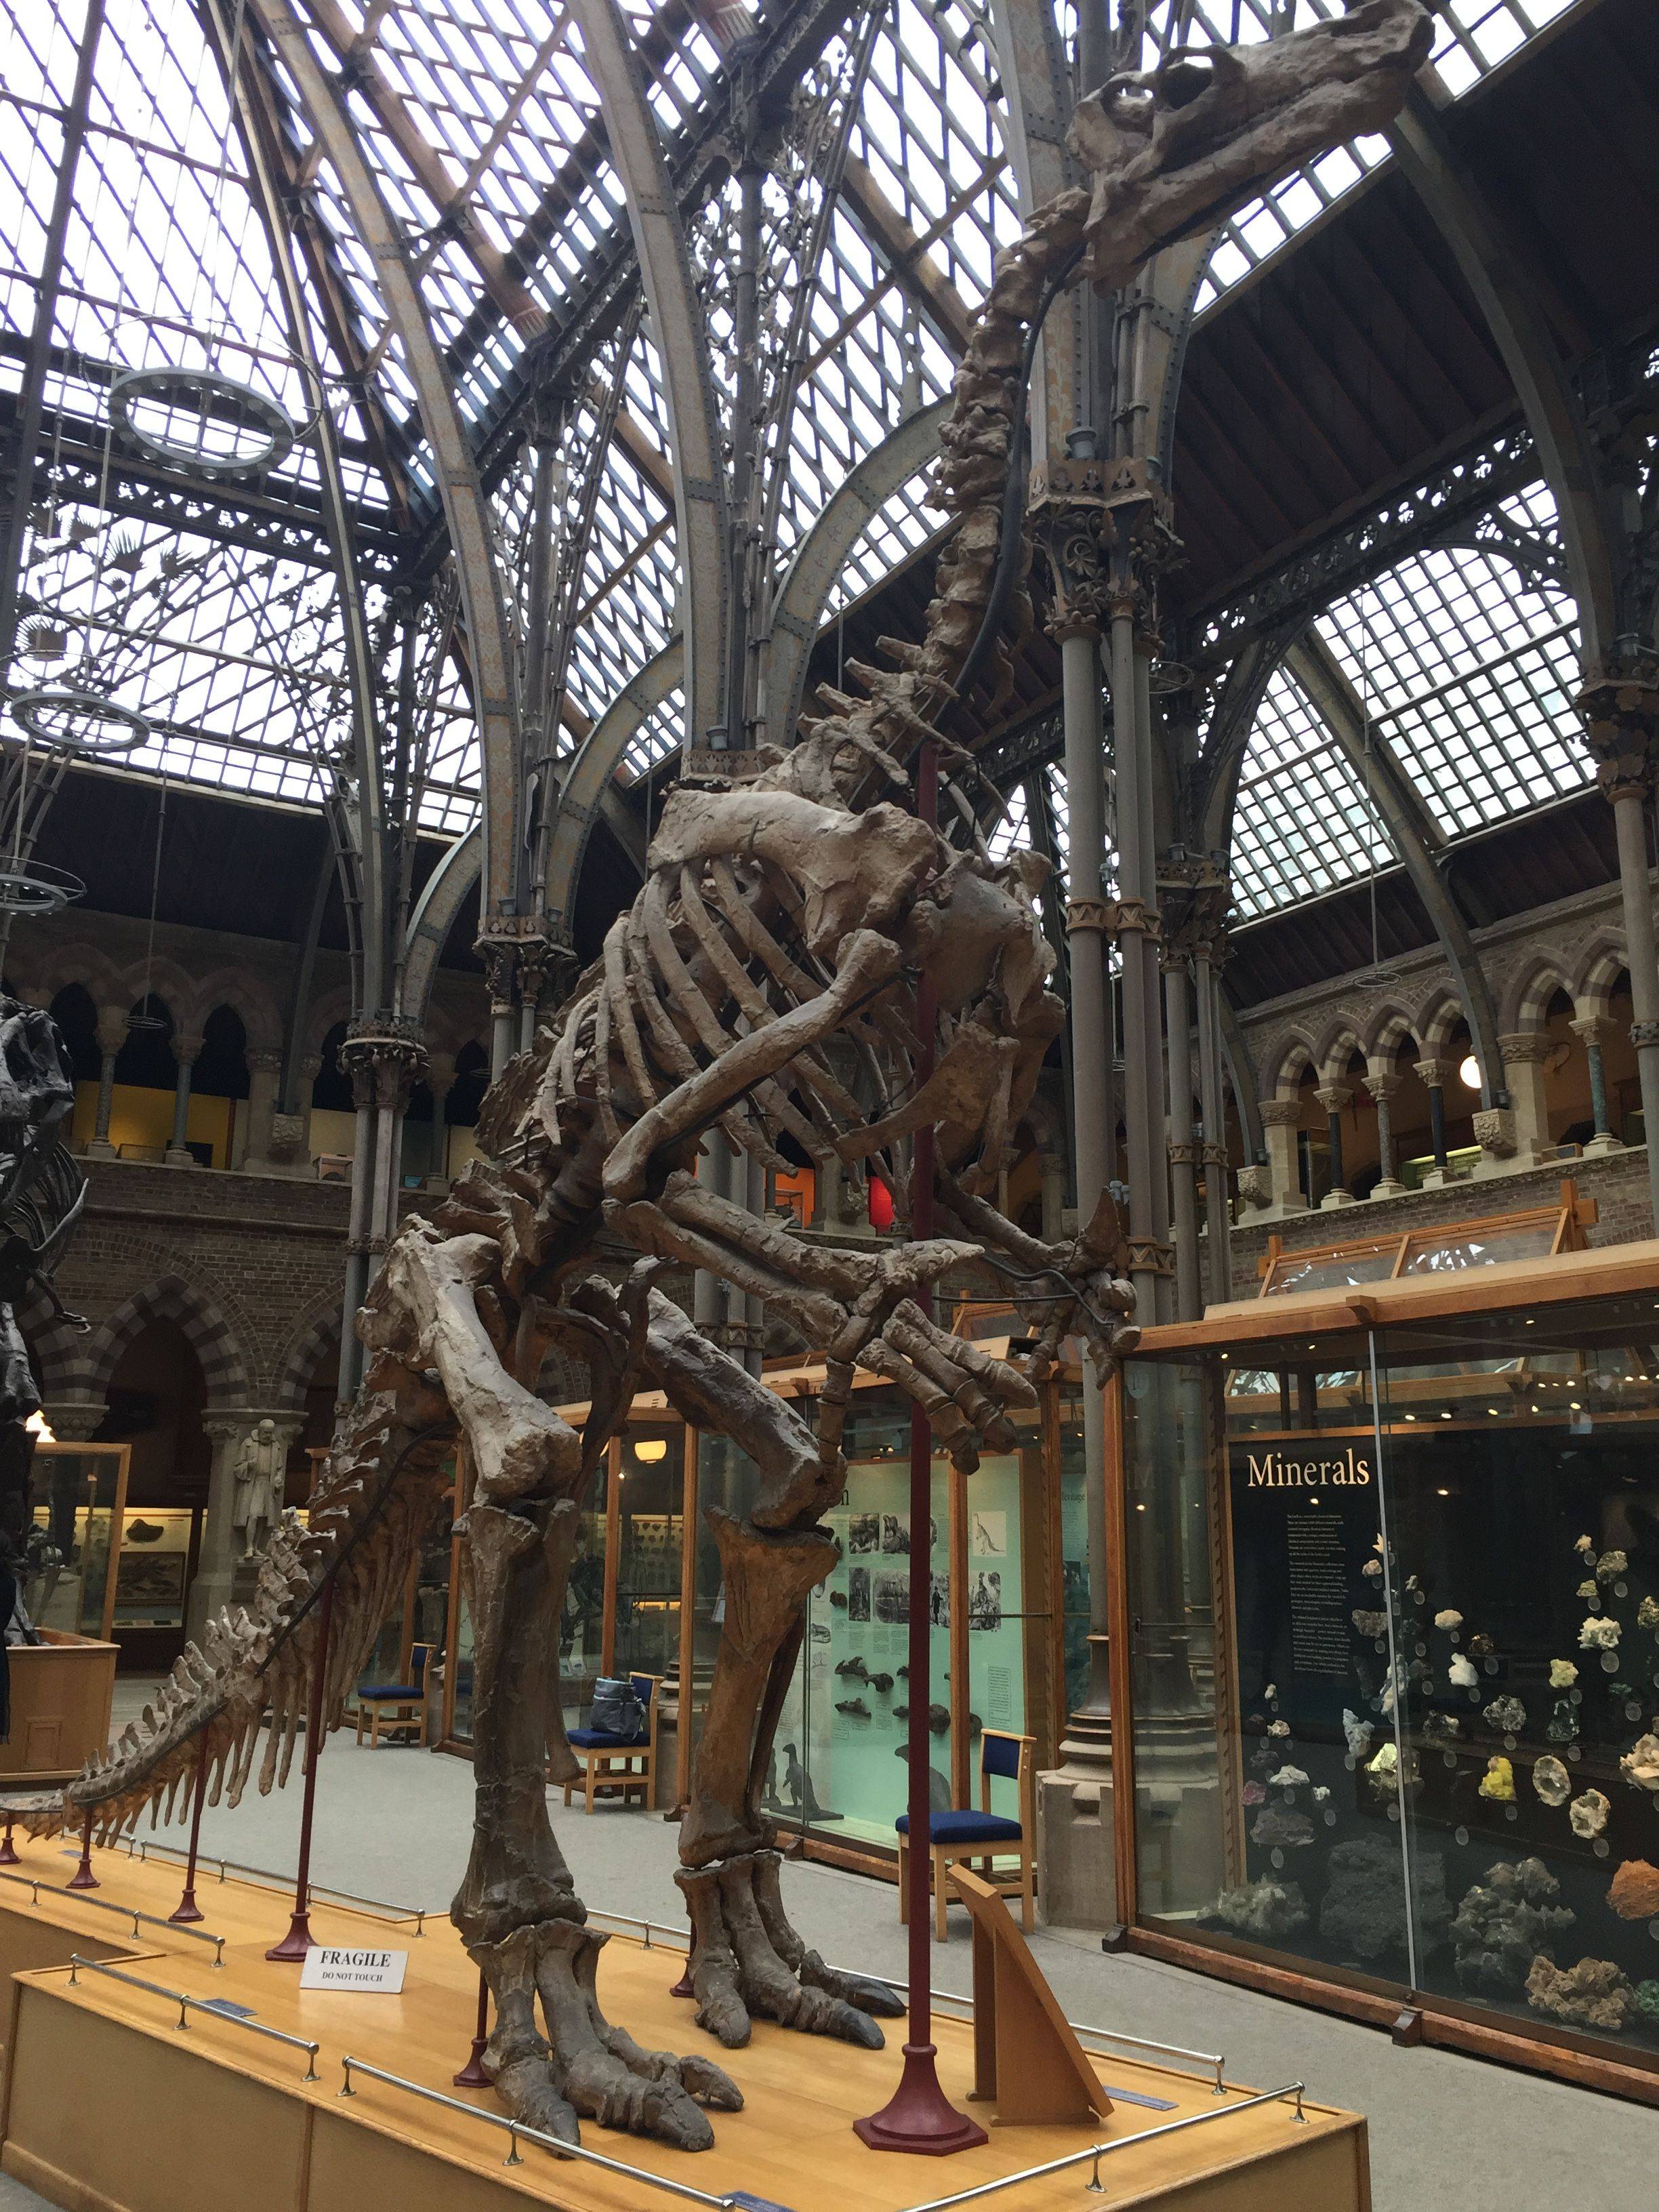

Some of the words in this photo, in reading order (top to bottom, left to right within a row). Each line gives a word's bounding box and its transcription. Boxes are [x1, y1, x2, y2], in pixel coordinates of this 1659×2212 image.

[1247, 1448, 1370, 1488] Minerals
[320, 1950, 391, 1967] FRAGILE
[322, 1971, 334, 1980] DO
[336, 1972, 353, 1981] NOT
[354, 1973, 383, 1982] TOUCH
